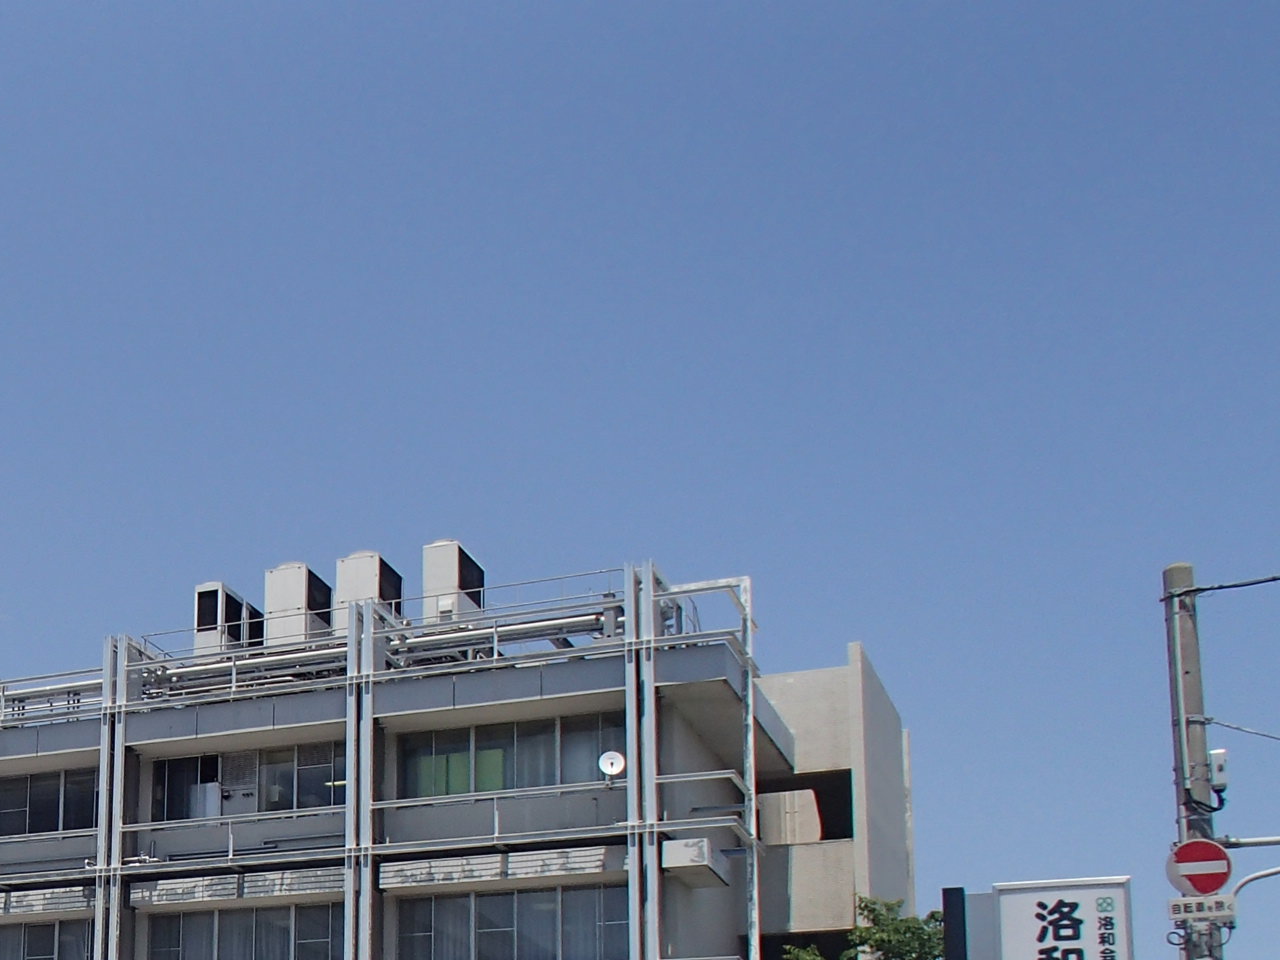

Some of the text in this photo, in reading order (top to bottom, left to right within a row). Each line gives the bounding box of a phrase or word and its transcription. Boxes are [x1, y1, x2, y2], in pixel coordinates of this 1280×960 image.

[1171, 901, 1234, 914] 自転車を除く
